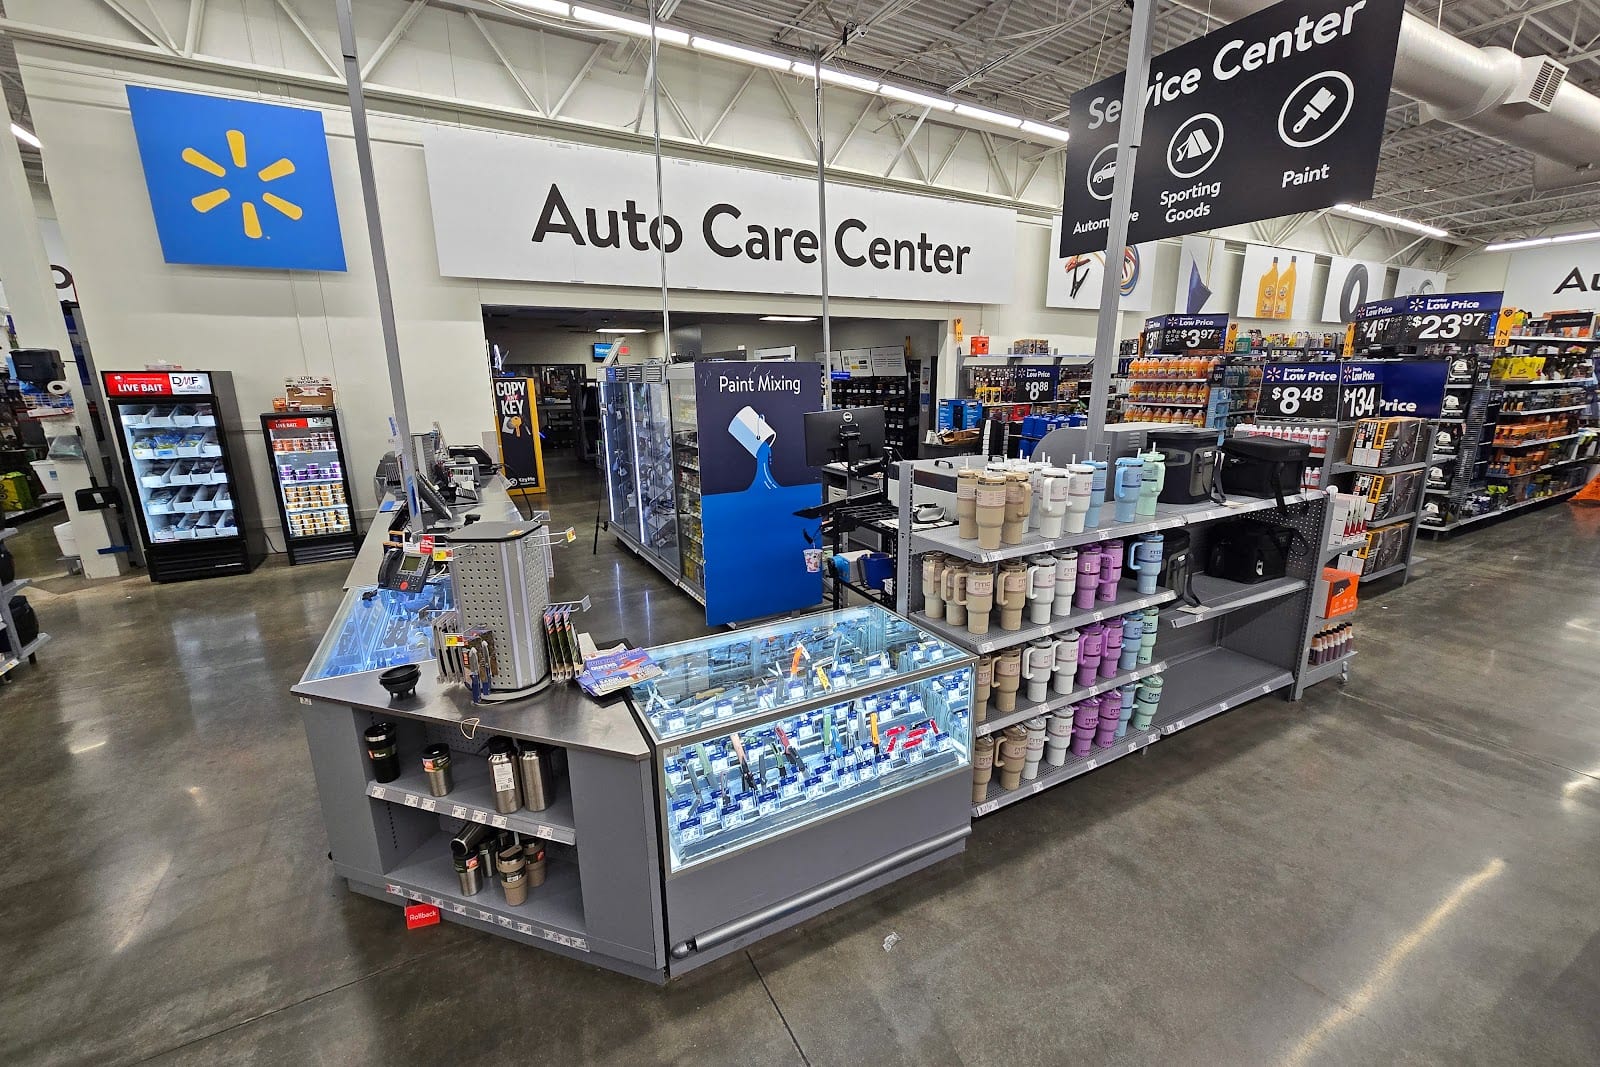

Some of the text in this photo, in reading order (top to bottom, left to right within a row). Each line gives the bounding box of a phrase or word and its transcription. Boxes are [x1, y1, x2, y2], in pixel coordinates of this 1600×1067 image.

[1088, 0, 1367, 130] Seice Center
[1281, 164, 1330, 188] Paint
[1160, 182, 1221, 208] Sporting
[1165, 202, 1210, 223] Goods
[532, 183, 971, 275] Auto Care Center
[1073, 211, 1139, 235] Autome
[1366, 306, 1393, 317] Low Price
[1426, 299, 1480, 311] Low Price
[1282, 371, 1338, 382] Low Price
[1352, 370, 1375, 381] Low Price
[118, 383, 164, 392] LIVE BAIT
[495, 381, 526, 397] COPY
[719, 376, 755, 393] Paint
[757, 375, 801, 394] Mixing
[500, 400, 524, 415] KEY
[1379, 398, 1417, 412] Price
[409, 910, 437, 921] Rollback
